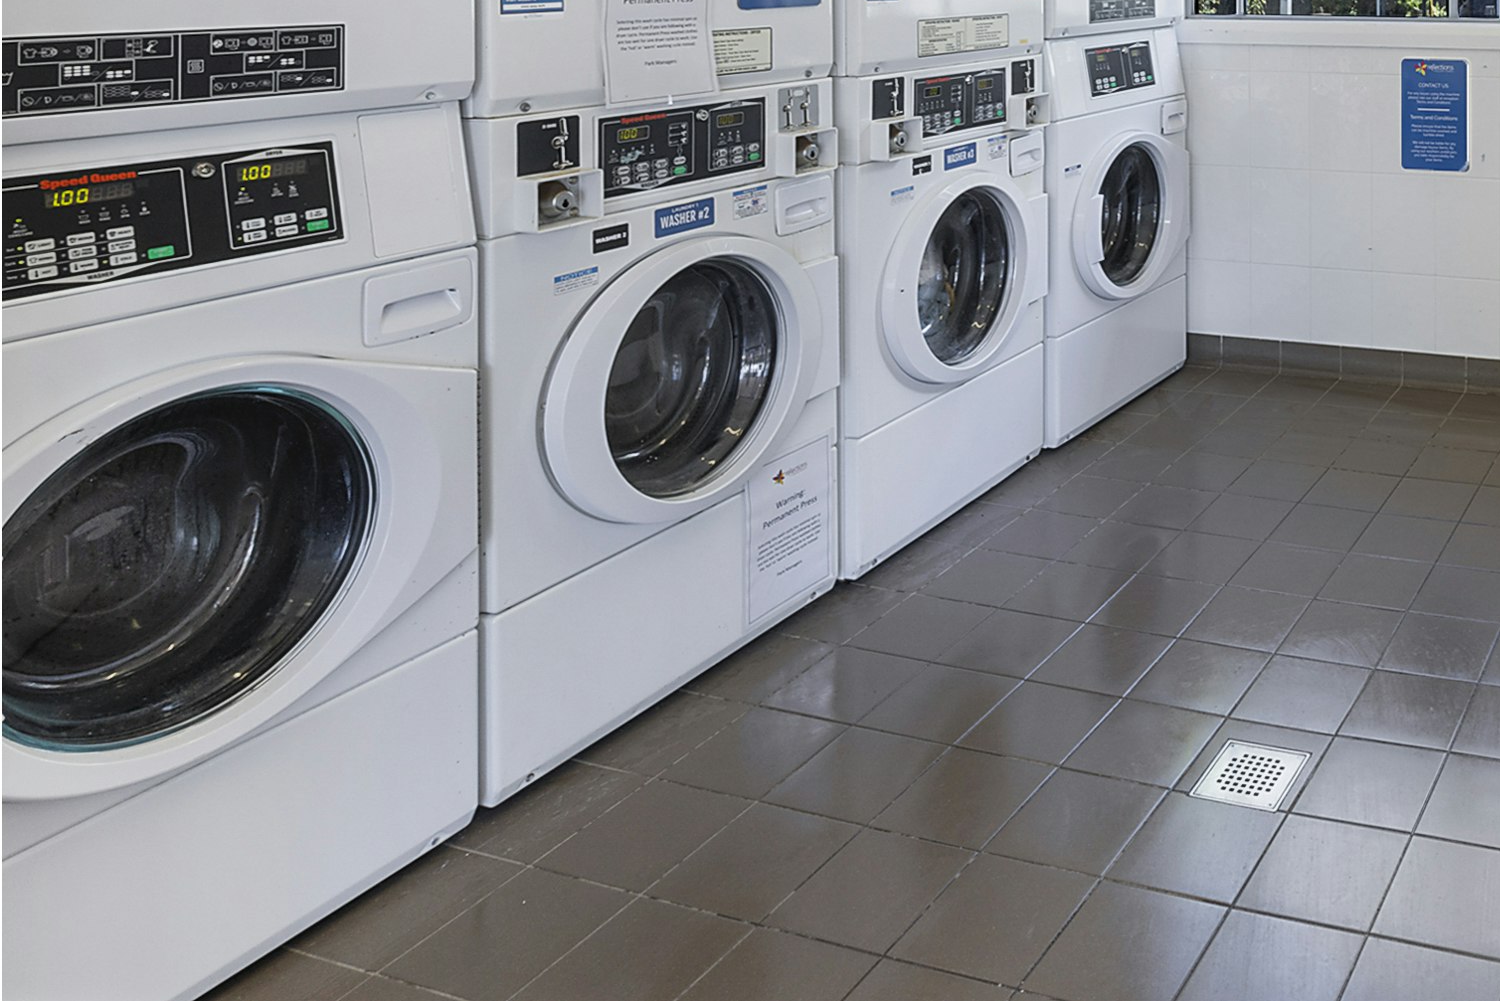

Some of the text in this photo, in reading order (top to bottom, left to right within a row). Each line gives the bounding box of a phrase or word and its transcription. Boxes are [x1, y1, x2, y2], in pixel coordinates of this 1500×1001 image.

[39, 171, 137, 190] Speed Queen
[660, 206, 710, 229] WASHER #2
[595, 233, 621, 244] WASHER
[87, 270, 114, 280] WASHER
[762, 496, 818, 530] Permanent Press
